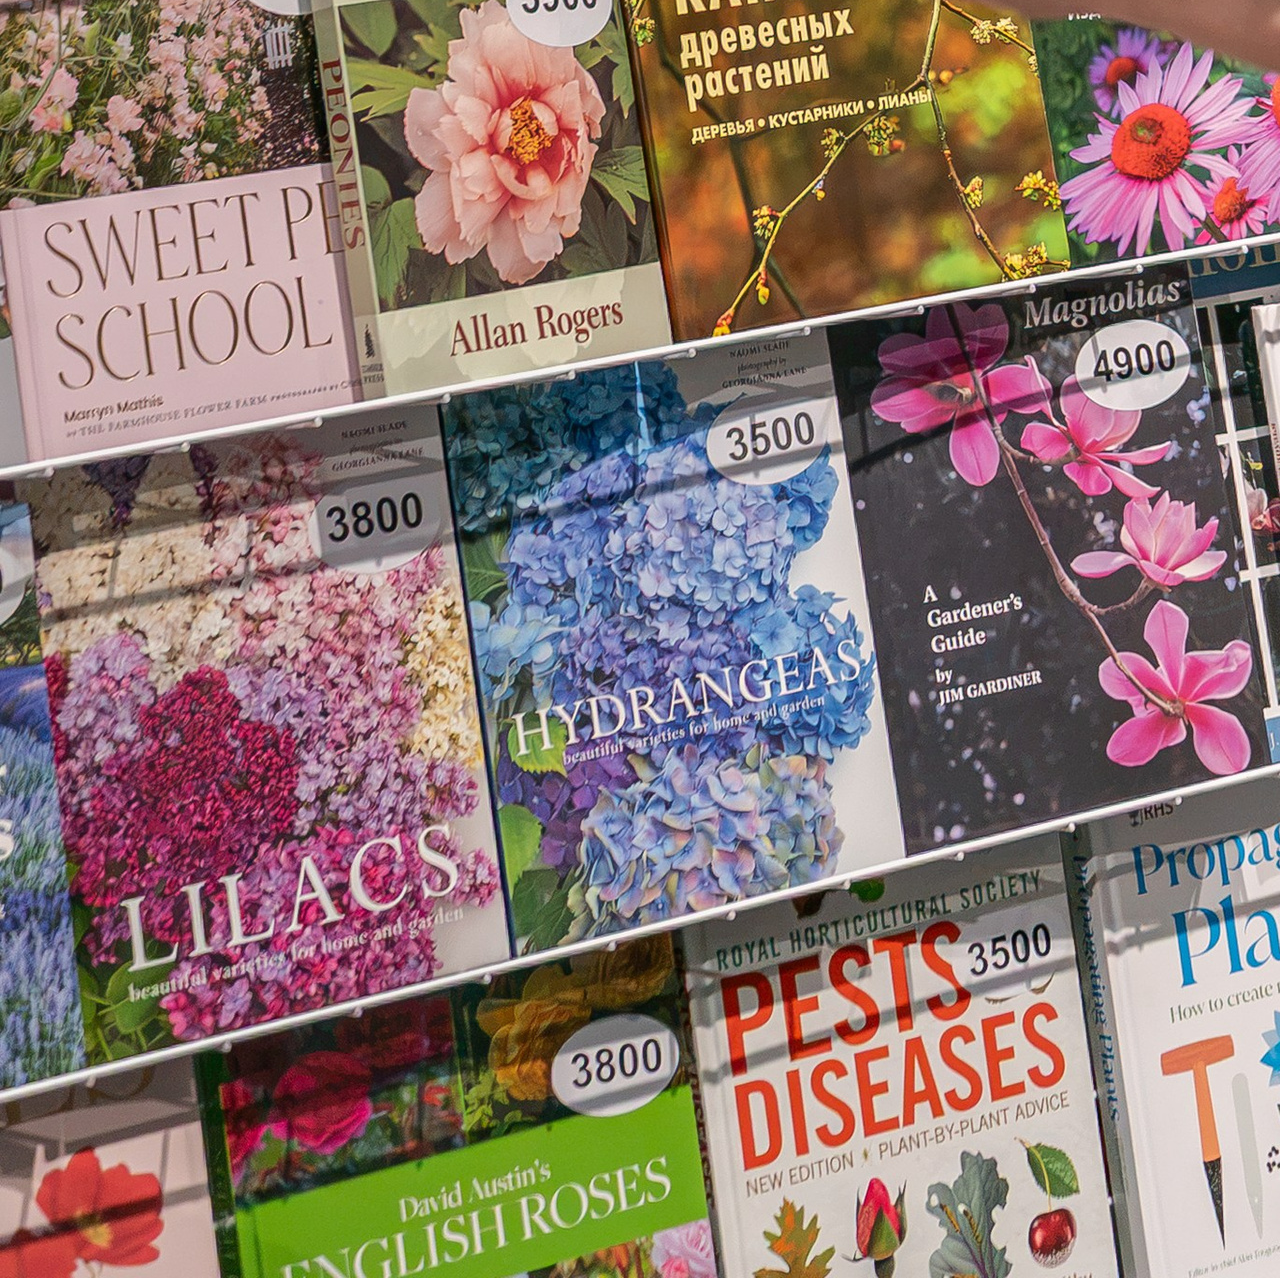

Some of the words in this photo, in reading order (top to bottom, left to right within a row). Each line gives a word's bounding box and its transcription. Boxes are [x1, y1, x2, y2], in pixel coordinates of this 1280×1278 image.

[680, 6, 856, 71] древесных
[684, 45, 832, 112] растений
[691, 118, 756, 146] ДЕРЕВЬЯ
[768, 99, 866, 131] КУСТАРНИКИ
[878, 88, 934, 112] ЛИАНЫ
[321, 57, 366, 251] PEONIES
[43, 190, 263, 301] SWEET
[54, 275, 335, 391] SCHOOL
[449, 309, 527, 359] Allan
[533, 295, 625, 348] Rogers
[1023, 277, 1183, 332] Magnolias
[1092, 338, 1178, 385] 4900
[725, 410, 815, 462] 3500
[326, 491, 423, 545] 3800
[926, 592, 1024, 630] Gardener's
[930, 627, 987, 655] Guide
[511, 637, 862, 758] HYDRANGEAS
[938, 684, 965, 707] JIM
[966, 668, 1044, 701] GARDINER
[562, 739, 626, 767] beautiful
[711, 709, 751, 732] home
[781, 694, 826, 721] garden
[118, 822, 460, 975] LILACS
[716, 935, 781, 973] ROYAL
[788, 897, 953, 954] HORTICULTURAL
[960, 867, 1042, 912] SOCIETY
[127, 965, 209, 1004] beautiful
[290, 939, 316, 963] for
[320, 929, 368, 954] home
[371, 917, 404, 942] and
[407, 904, 465, 940] garden
[967, 921, 1052, 978] 3500
[720, 919, 972, 1078] PESTS
[1168, 997, 1206, 1026] How
[1226, 981, 1275, 1009] create
[570, 1037, 663, 1089] 3800
[734, 1001, 1067, 1173] DISEASES
[1013, 1090, 1071, 1125] ADVICE
[745, 1168, 785, 1199] NEW
[788, 1153, 855, 1187] EDITION
[877, 1106, 1011, 1163] PLANT-BY-PLANT
[398, 1180, 463, 1223] David
[468, 1158, 552, 1205] Austin's
[518, 1154, 672, 1242] ROSES
